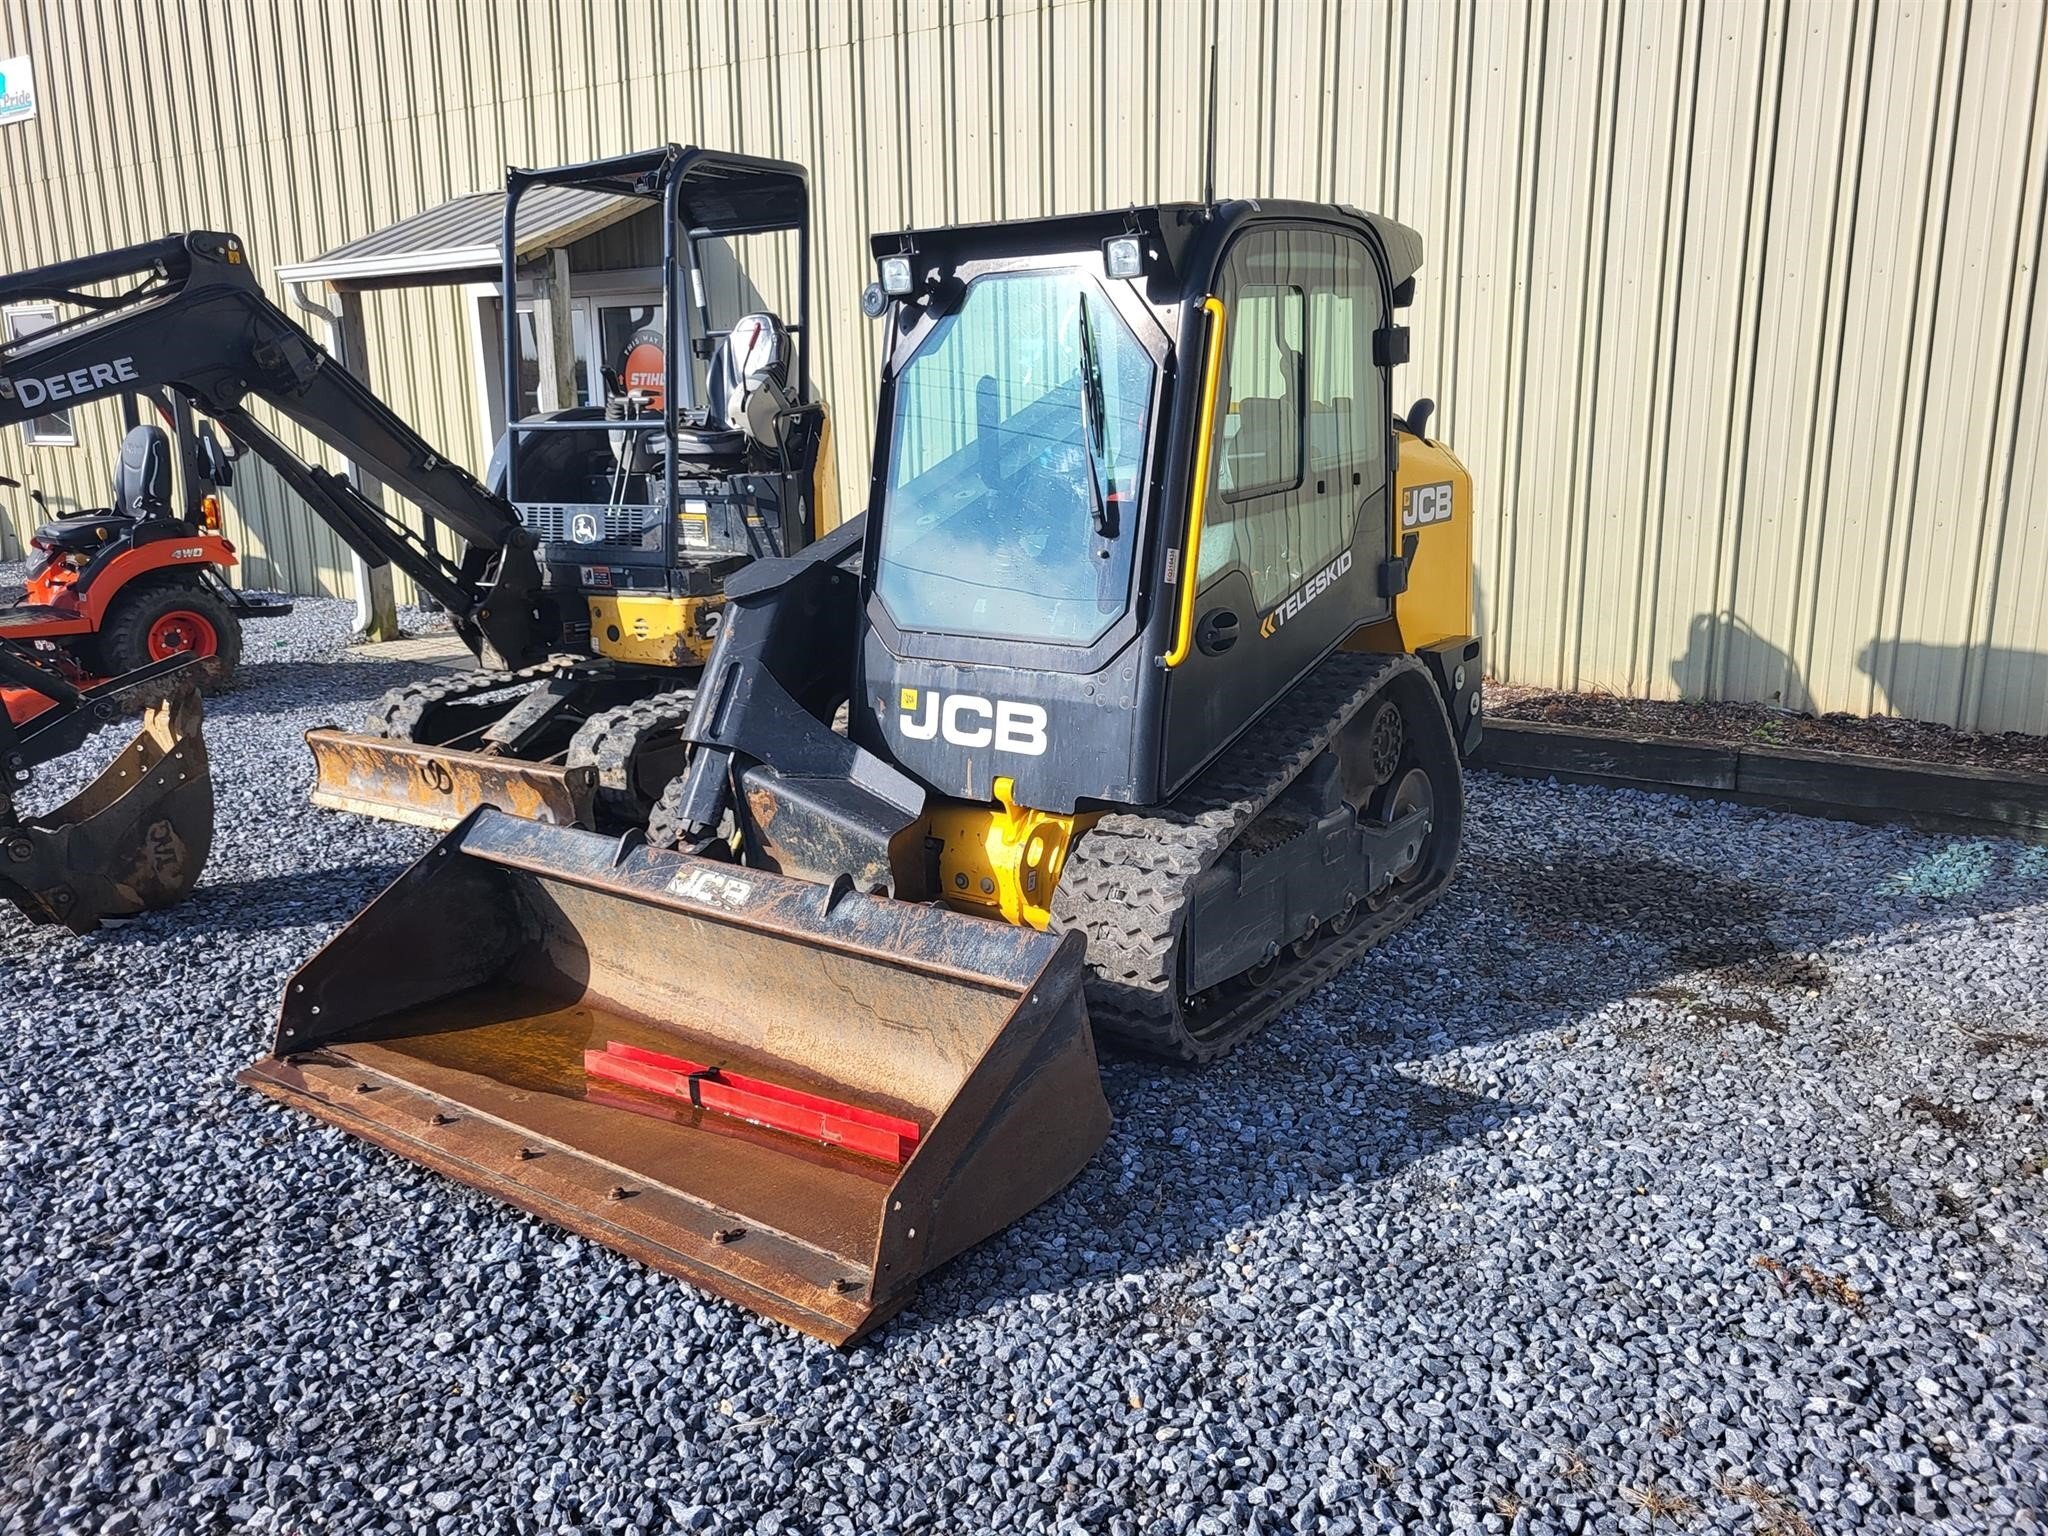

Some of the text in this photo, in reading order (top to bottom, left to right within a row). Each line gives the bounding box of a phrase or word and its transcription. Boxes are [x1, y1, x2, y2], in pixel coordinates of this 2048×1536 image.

[4, 90, 31, 107] Pride
[14, 356, 139, 408] DEERE
[1403, 485, 1452, 526] JCB
[171, 547, 203, 559] 4WD
[1275, 550, 1352, 626] TELESKID
[900, 690, 1049, 756] JCB
[664, 867, 753, 907] JCB
